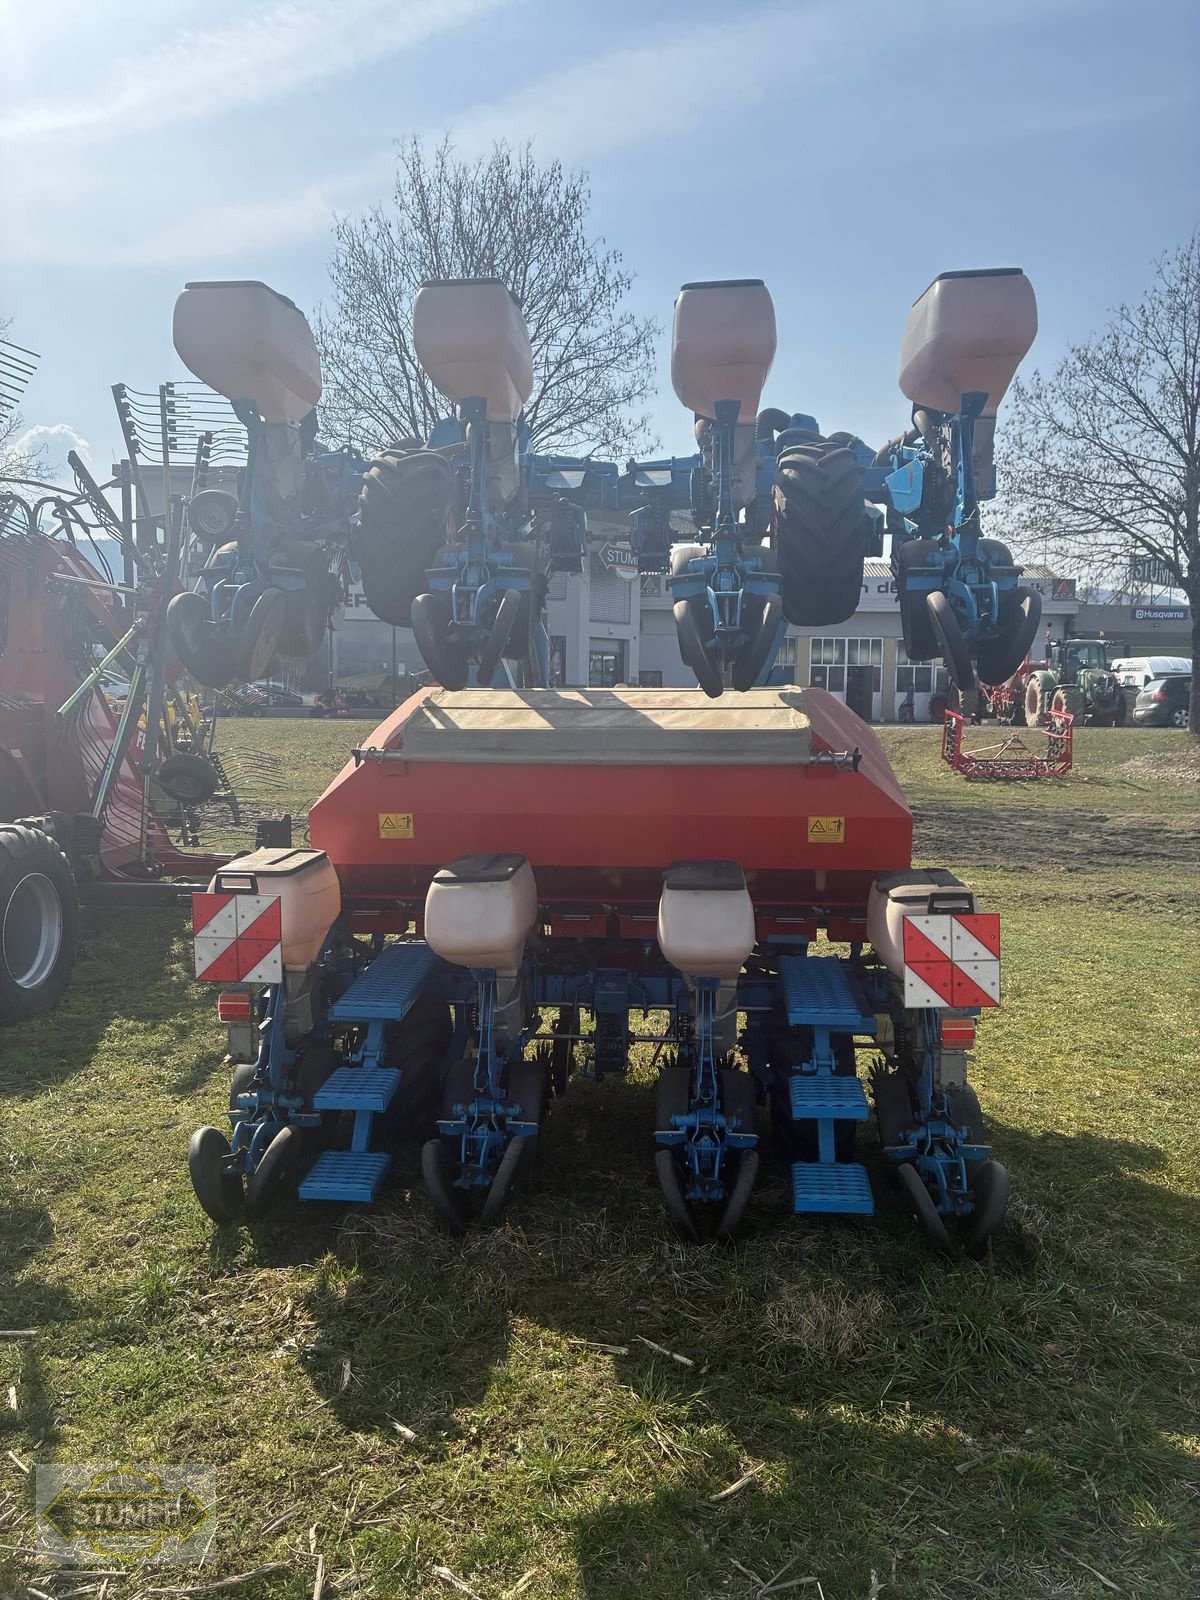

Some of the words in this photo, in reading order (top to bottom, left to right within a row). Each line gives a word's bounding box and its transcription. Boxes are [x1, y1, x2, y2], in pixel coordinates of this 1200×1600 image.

[607, 549, 639, 565] STUM
[877, 581, 899, 594] de
[1144, 609, 1184, 620] Husqvarna
